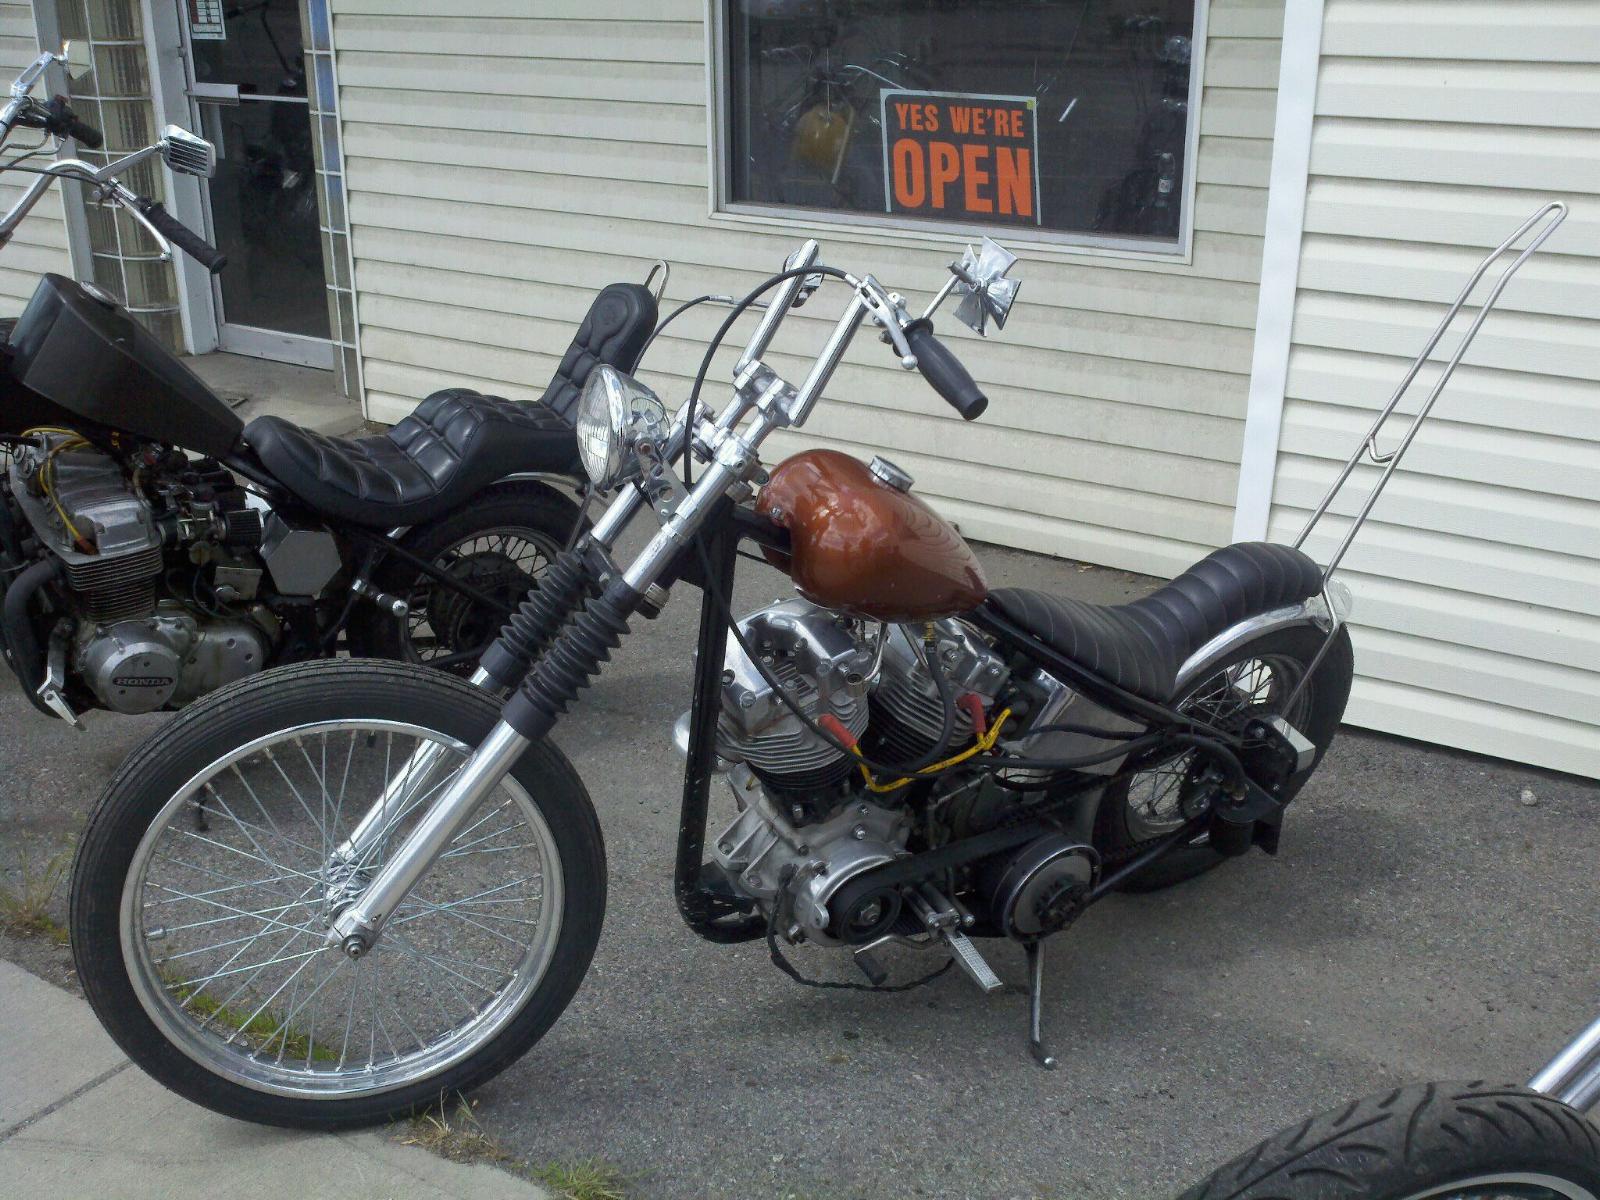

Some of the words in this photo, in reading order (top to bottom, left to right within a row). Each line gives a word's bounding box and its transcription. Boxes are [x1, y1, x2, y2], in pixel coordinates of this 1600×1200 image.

[895, 103, 939, 132] YES
[949, 106, 1025, 137] WE'RE
[893, 138, 1032, 216] OPEN
[114, 677, 171, 686] HONDA
